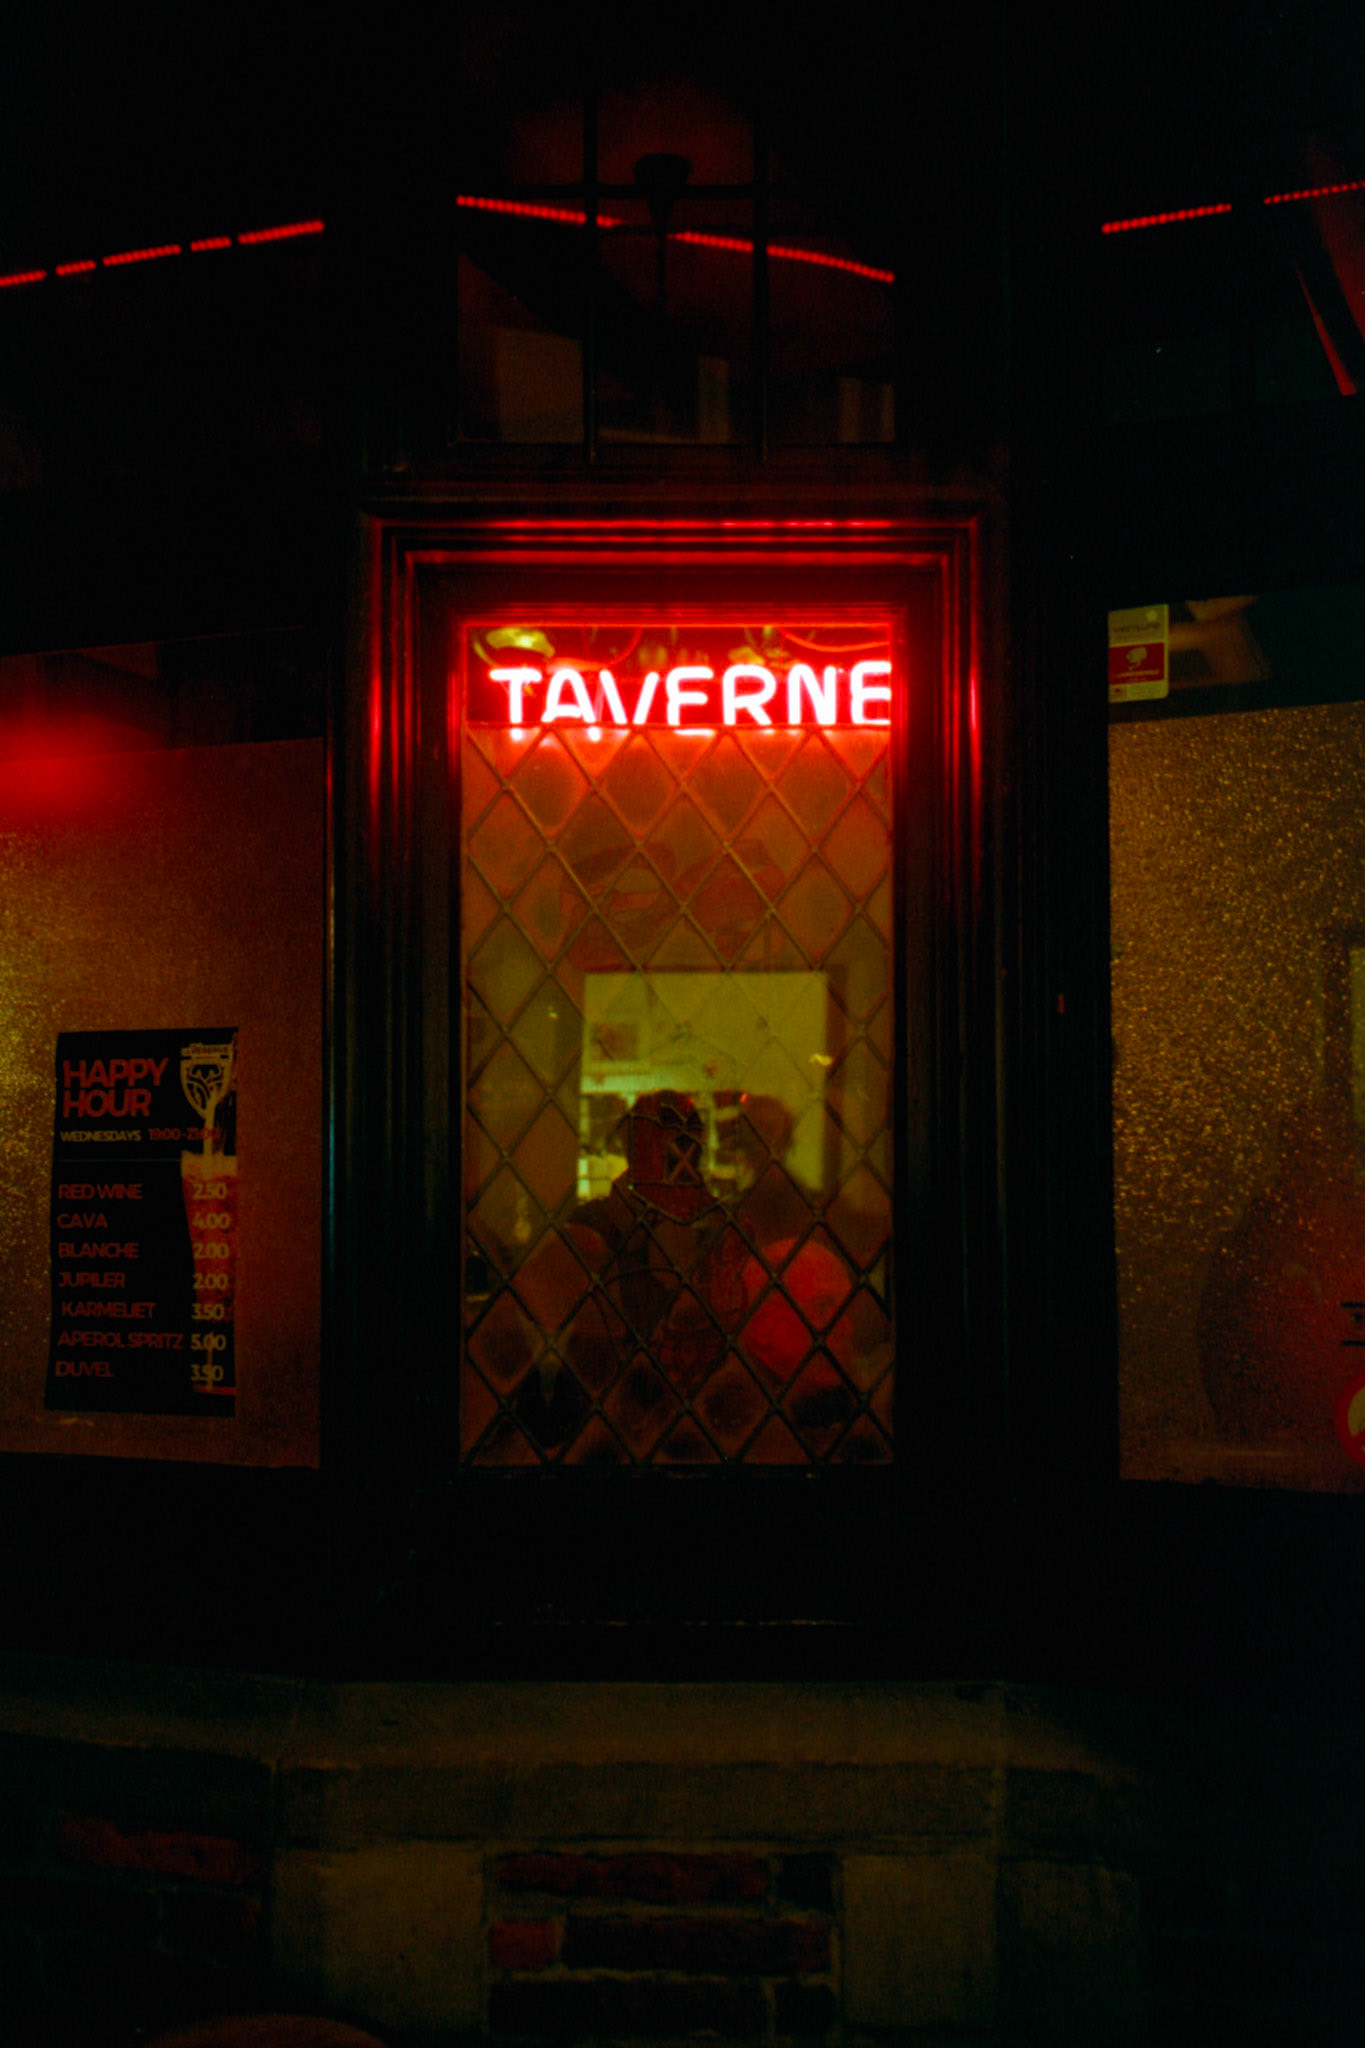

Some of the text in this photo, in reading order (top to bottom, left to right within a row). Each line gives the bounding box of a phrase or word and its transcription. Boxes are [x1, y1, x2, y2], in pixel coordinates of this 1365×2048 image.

[489, 660, 892, 740] TAVERNE
[62, 1057, 170, 1088] HAPPY
[62, 1088, 152, 1118] HOUR
[60, 1130, 143, 1143] WEDNESDAYS
[57, 1184, 95, 1200] RED
[97, 1184, 143, 1200] WINE
[56, 1212, 109, 1230] CAVA
[57, 1241, 140, 1259] BLANCHE
[57, 1271, 127, 1289] JUPILER
[61, 1301, 157, 1319] KARMELIET
[57, 1329, 125, 1349] APEROL
[127, 1331, 185, 1351] SPRITZ
[54, 1359, 115, 1378] DUVEL
